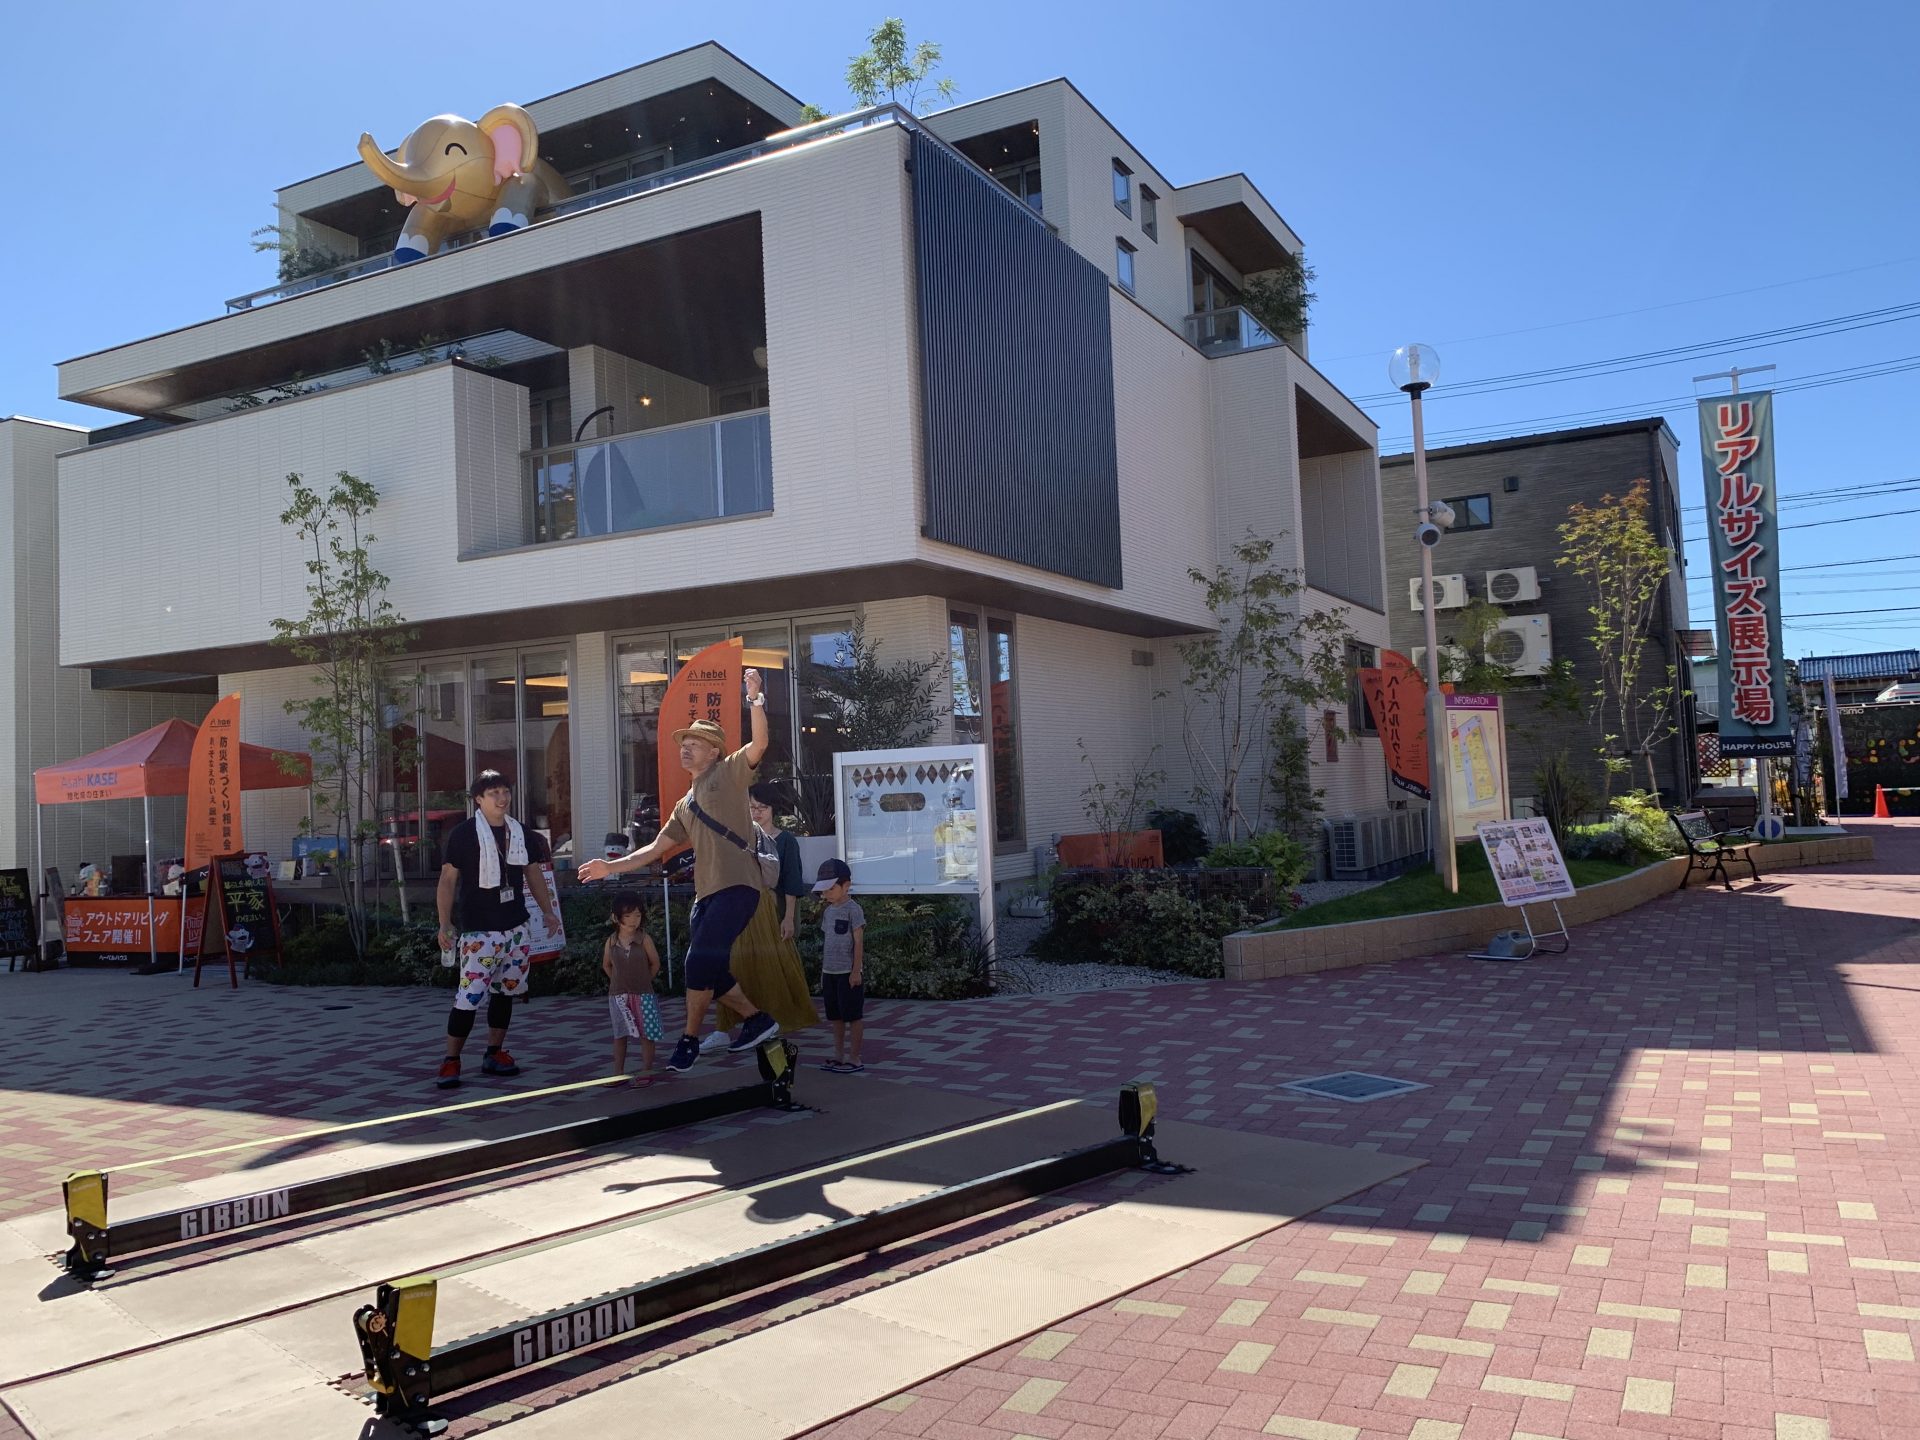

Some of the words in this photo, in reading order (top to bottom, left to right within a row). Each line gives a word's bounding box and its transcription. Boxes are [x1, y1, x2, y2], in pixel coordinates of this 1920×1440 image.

[1715, 400, 1774, 726] リアルサイズ展示場
[700, 669, 727, 679] hebel
[707, 692, 722, 723] 防災
[1454, 696, 1489, 705] INFORMATION
[1722, 742, 1756, 752] HAPPY
[1757, 740, 1792, 751] HOUSE
[180, 1189, 289, 1240] GIBBON
[513, 1295, 636, 1368] GIBBON
